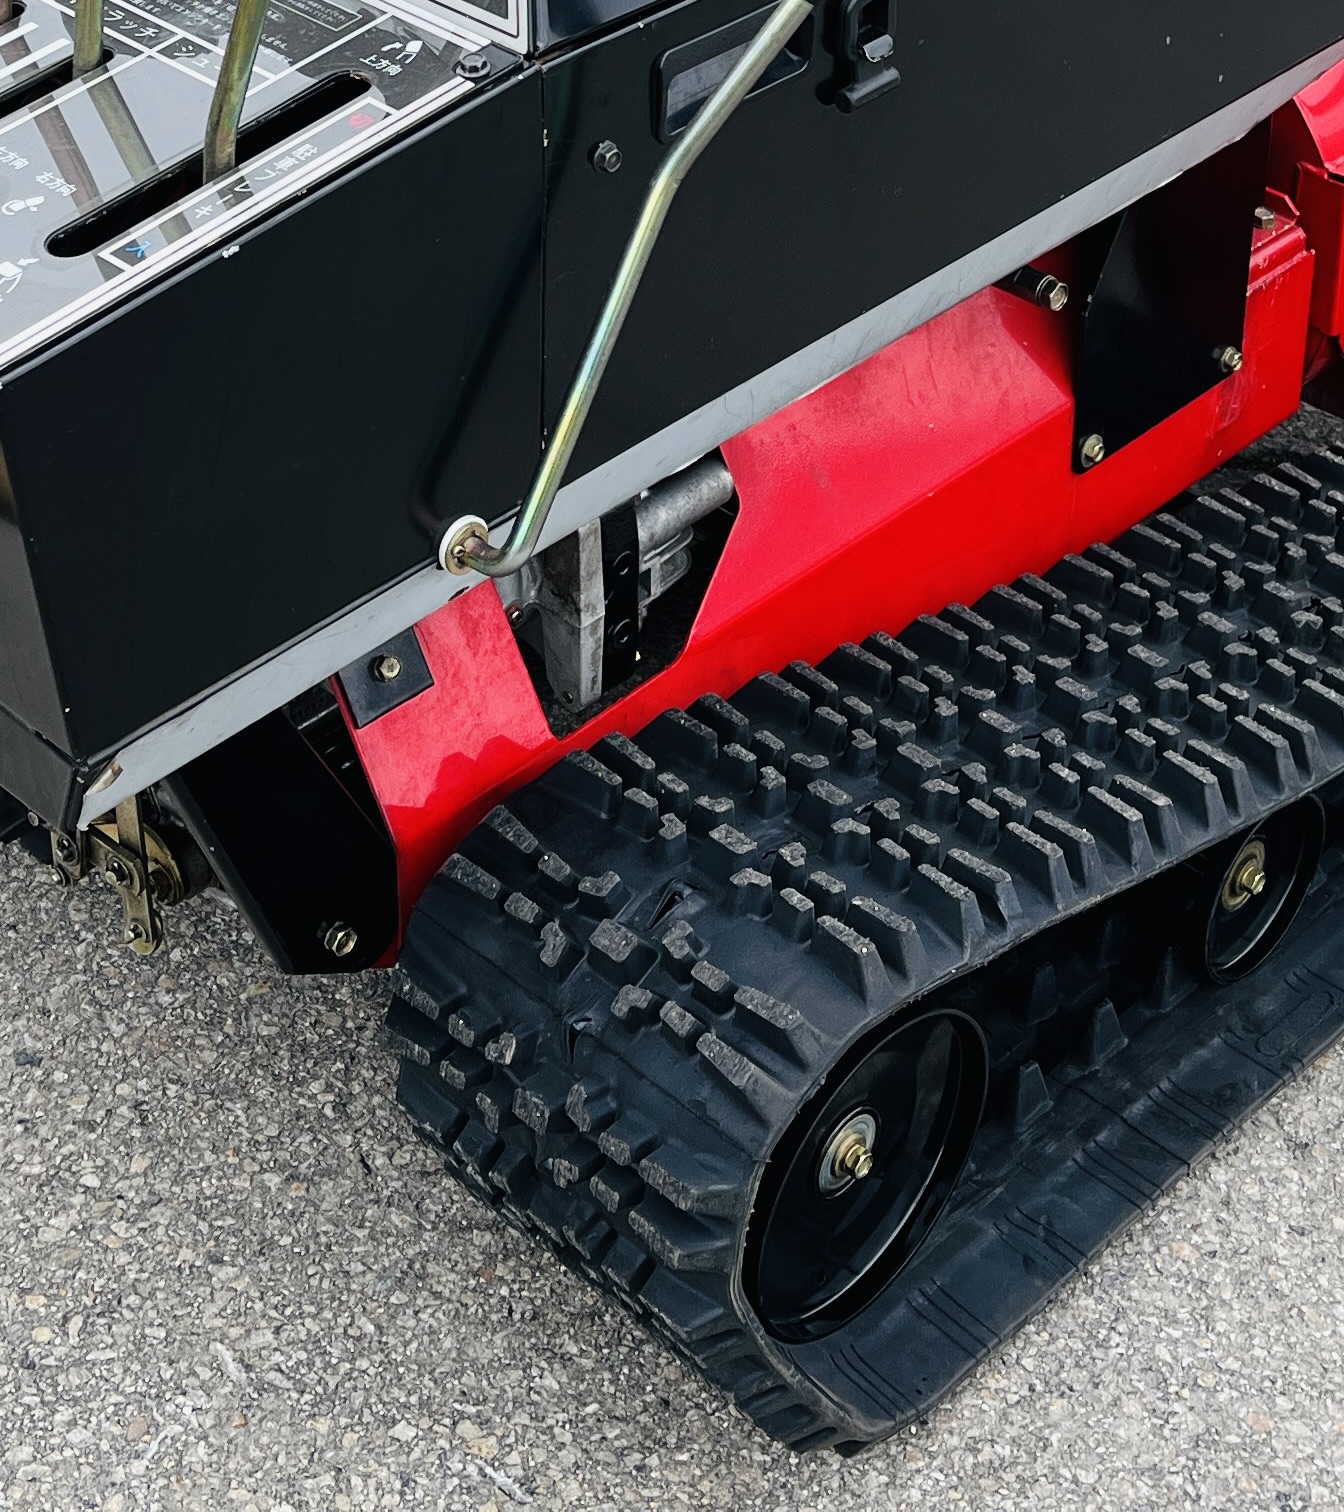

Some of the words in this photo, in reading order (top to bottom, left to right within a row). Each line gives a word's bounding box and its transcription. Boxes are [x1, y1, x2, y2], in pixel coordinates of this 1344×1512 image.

[358, 54, 404, 76] 上方向
[36, 171, 78, 197] 右方向
[194, 143, 319, 219] 駐車ブレーキ
[124, 240, 152, 259] 入
